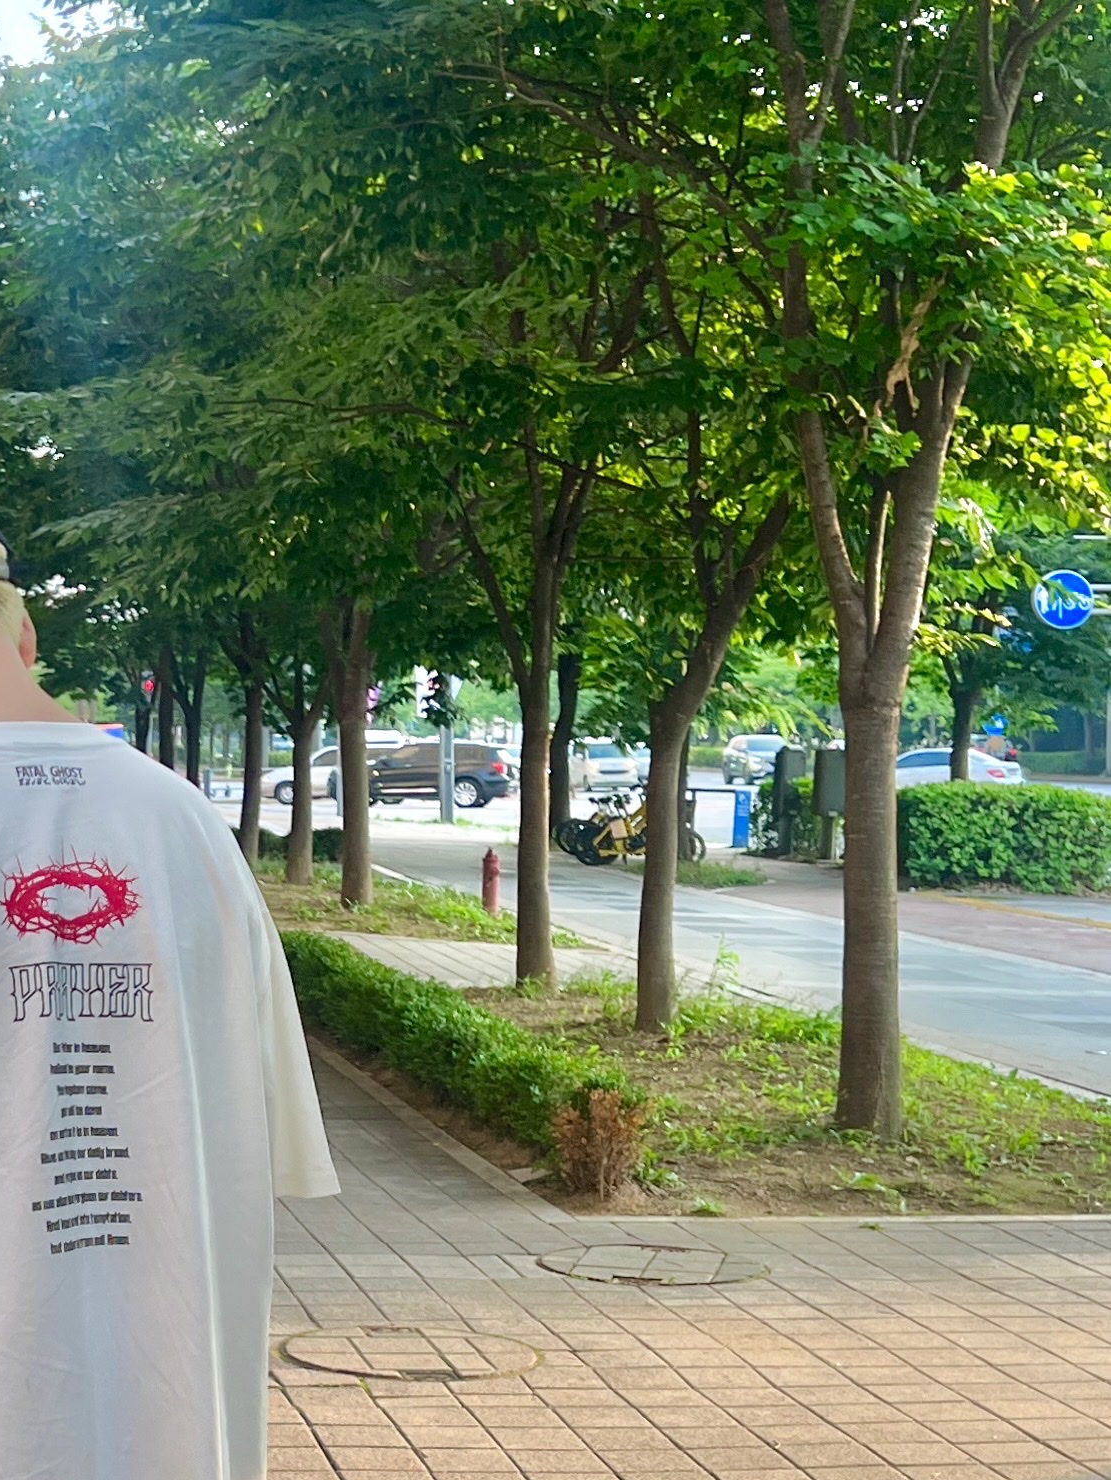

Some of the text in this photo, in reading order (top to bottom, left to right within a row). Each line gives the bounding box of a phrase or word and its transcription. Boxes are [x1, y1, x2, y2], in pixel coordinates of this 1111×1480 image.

[15, 764, 83, 778] FATAL GHOST
[9, 961, 154, 1022] PRAYER
